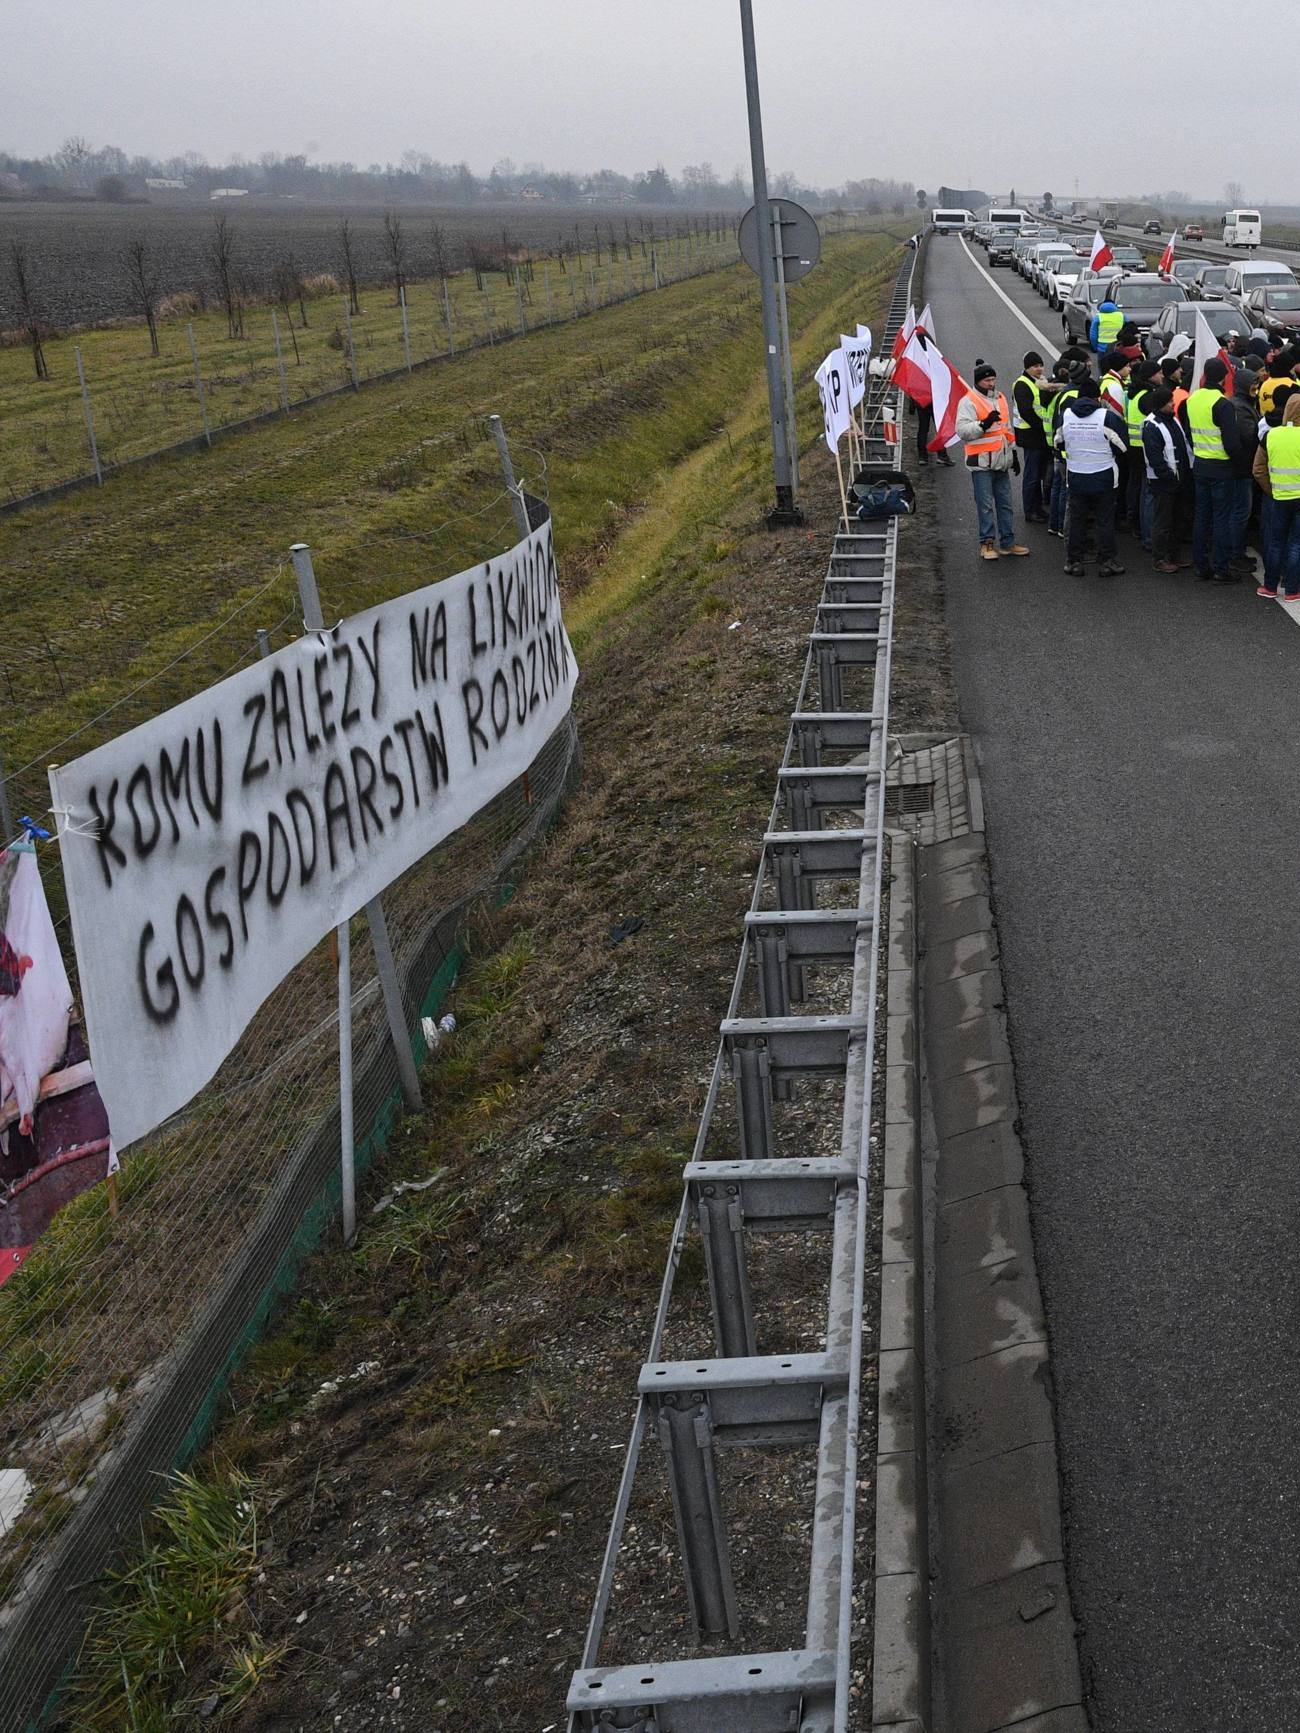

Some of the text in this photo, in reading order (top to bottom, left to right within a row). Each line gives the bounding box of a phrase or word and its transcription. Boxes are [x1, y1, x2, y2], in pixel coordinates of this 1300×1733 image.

[88, 717, 223, 890] KOMU
[410, 600, 447, 690] NA
[138, 701, 449, 1024] GOSPODARSTW
